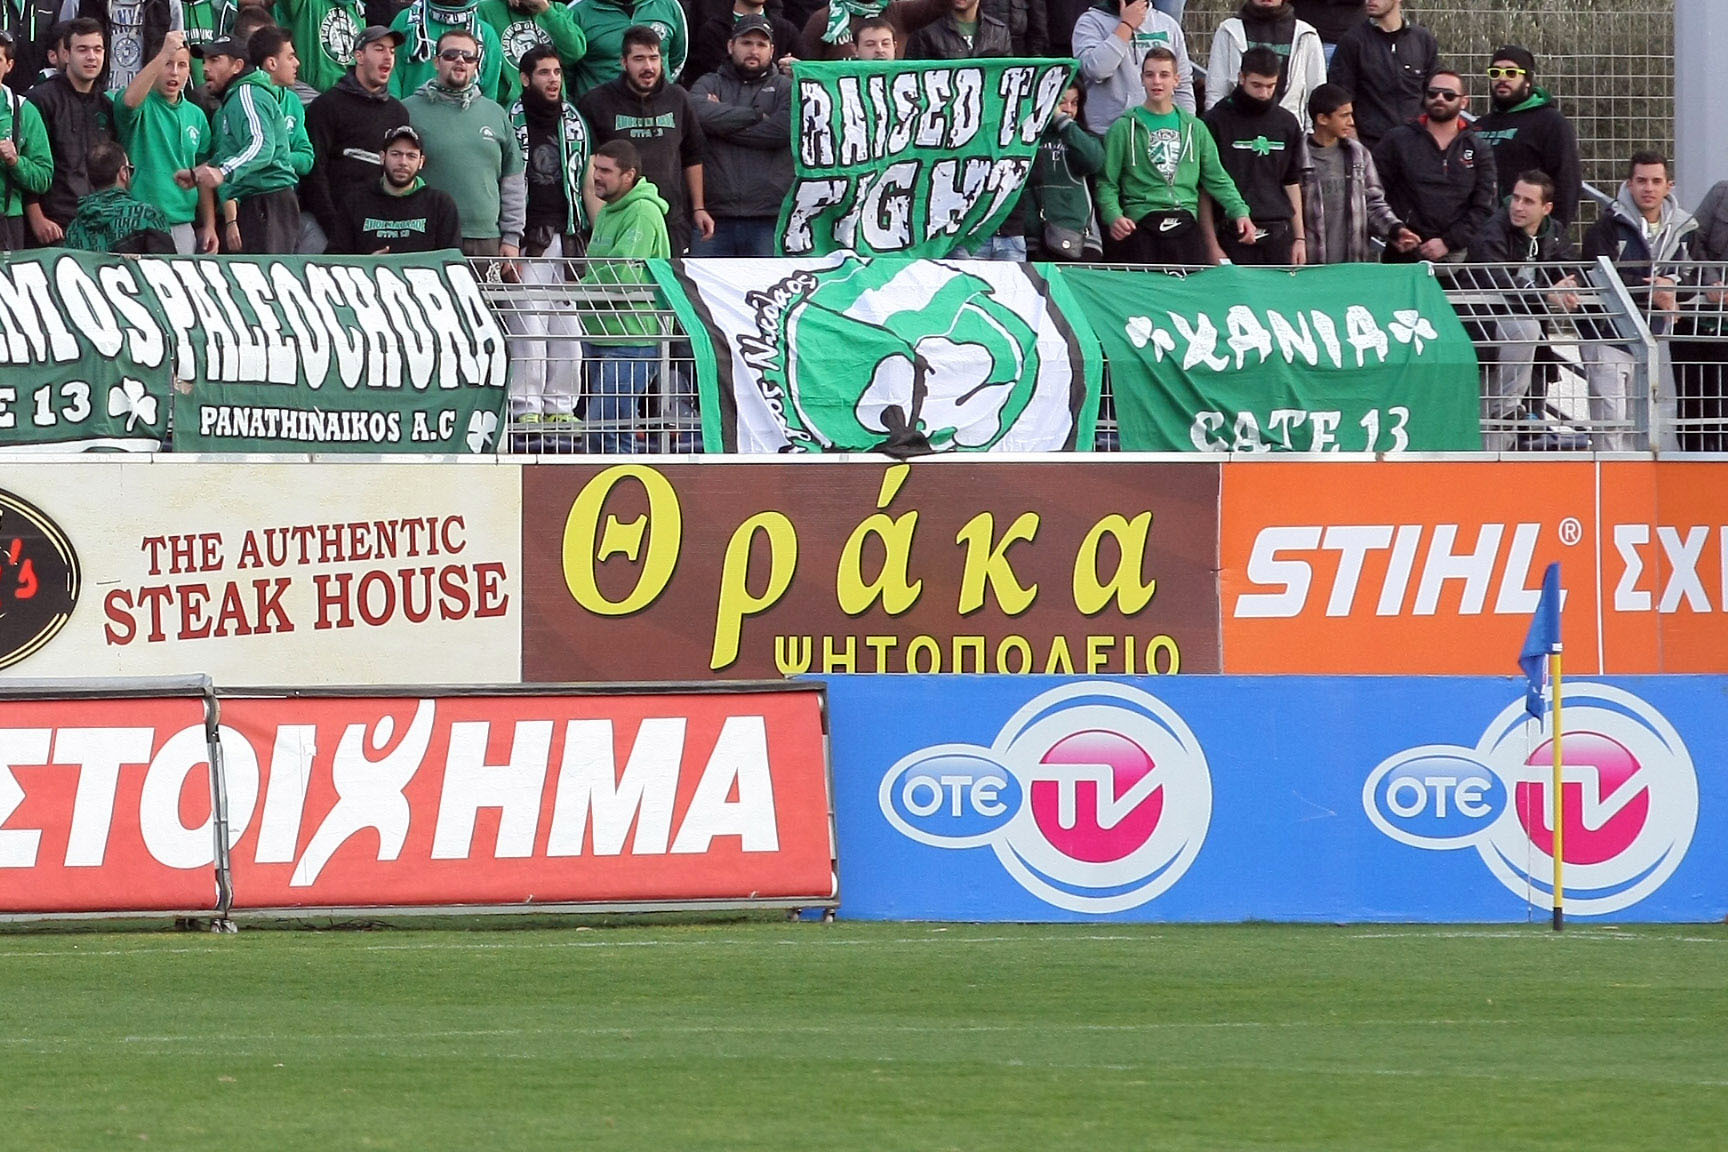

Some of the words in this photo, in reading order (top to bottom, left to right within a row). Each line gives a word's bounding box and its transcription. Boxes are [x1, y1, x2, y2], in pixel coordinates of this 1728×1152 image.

[800, 66, 985, 168] RAISED
[998, 63, 1071, 147] TO
[780, 154, 1032, 254] FIGHT
[149, 257, 509, 391] PALEOCHORA
[31, 380, 91, 426] 13
[199, 409, 402, 443] PANATHINAIKOS
[1358, 405, 1410, 452] 13
[141, 534, 223, 576] THE
[237, 513, 467, 570] AUTHENTIC
[560, 464, 1158, 672] Θράκα
[1233, 522, 1569, 620] STIHL
[1612, 524, 1728, 614] ΣΧ
[103, 578, 293, 647] STEAK
[314, 560, 511, 631] HOUSE
[1029, 763, 1163, 831] TV
[1514, 764, 1650, 832] TV
